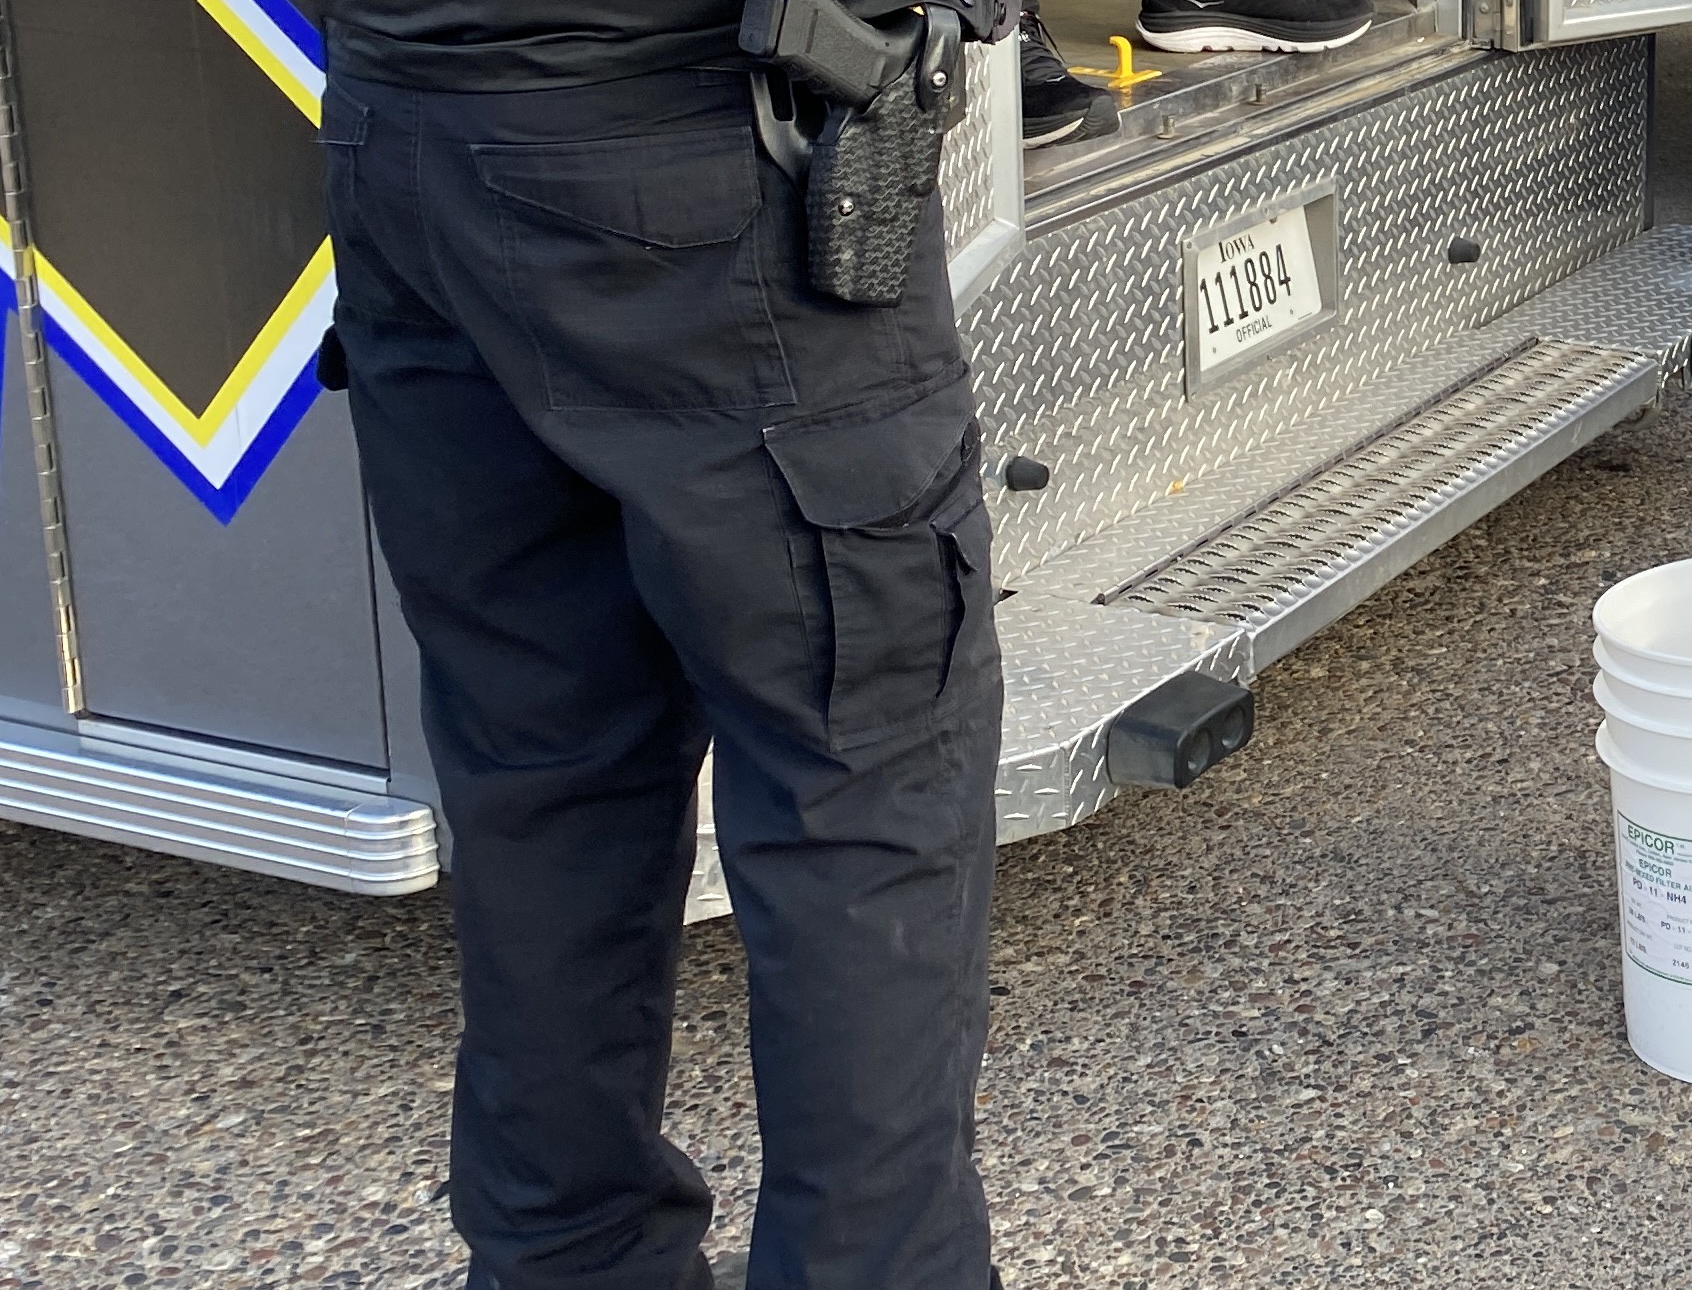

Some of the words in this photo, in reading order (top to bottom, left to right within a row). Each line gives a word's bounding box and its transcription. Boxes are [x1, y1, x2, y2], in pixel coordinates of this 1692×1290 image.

[1200, 243, 1292, 334] 111884
[1236, 315, 1273, 343] OFFICIAL
[1628, 824, 1674, 855] EPICOR
[1638, 858, 1672, 878] EPICOR
[1666, 891, 1687, 904] NH4
